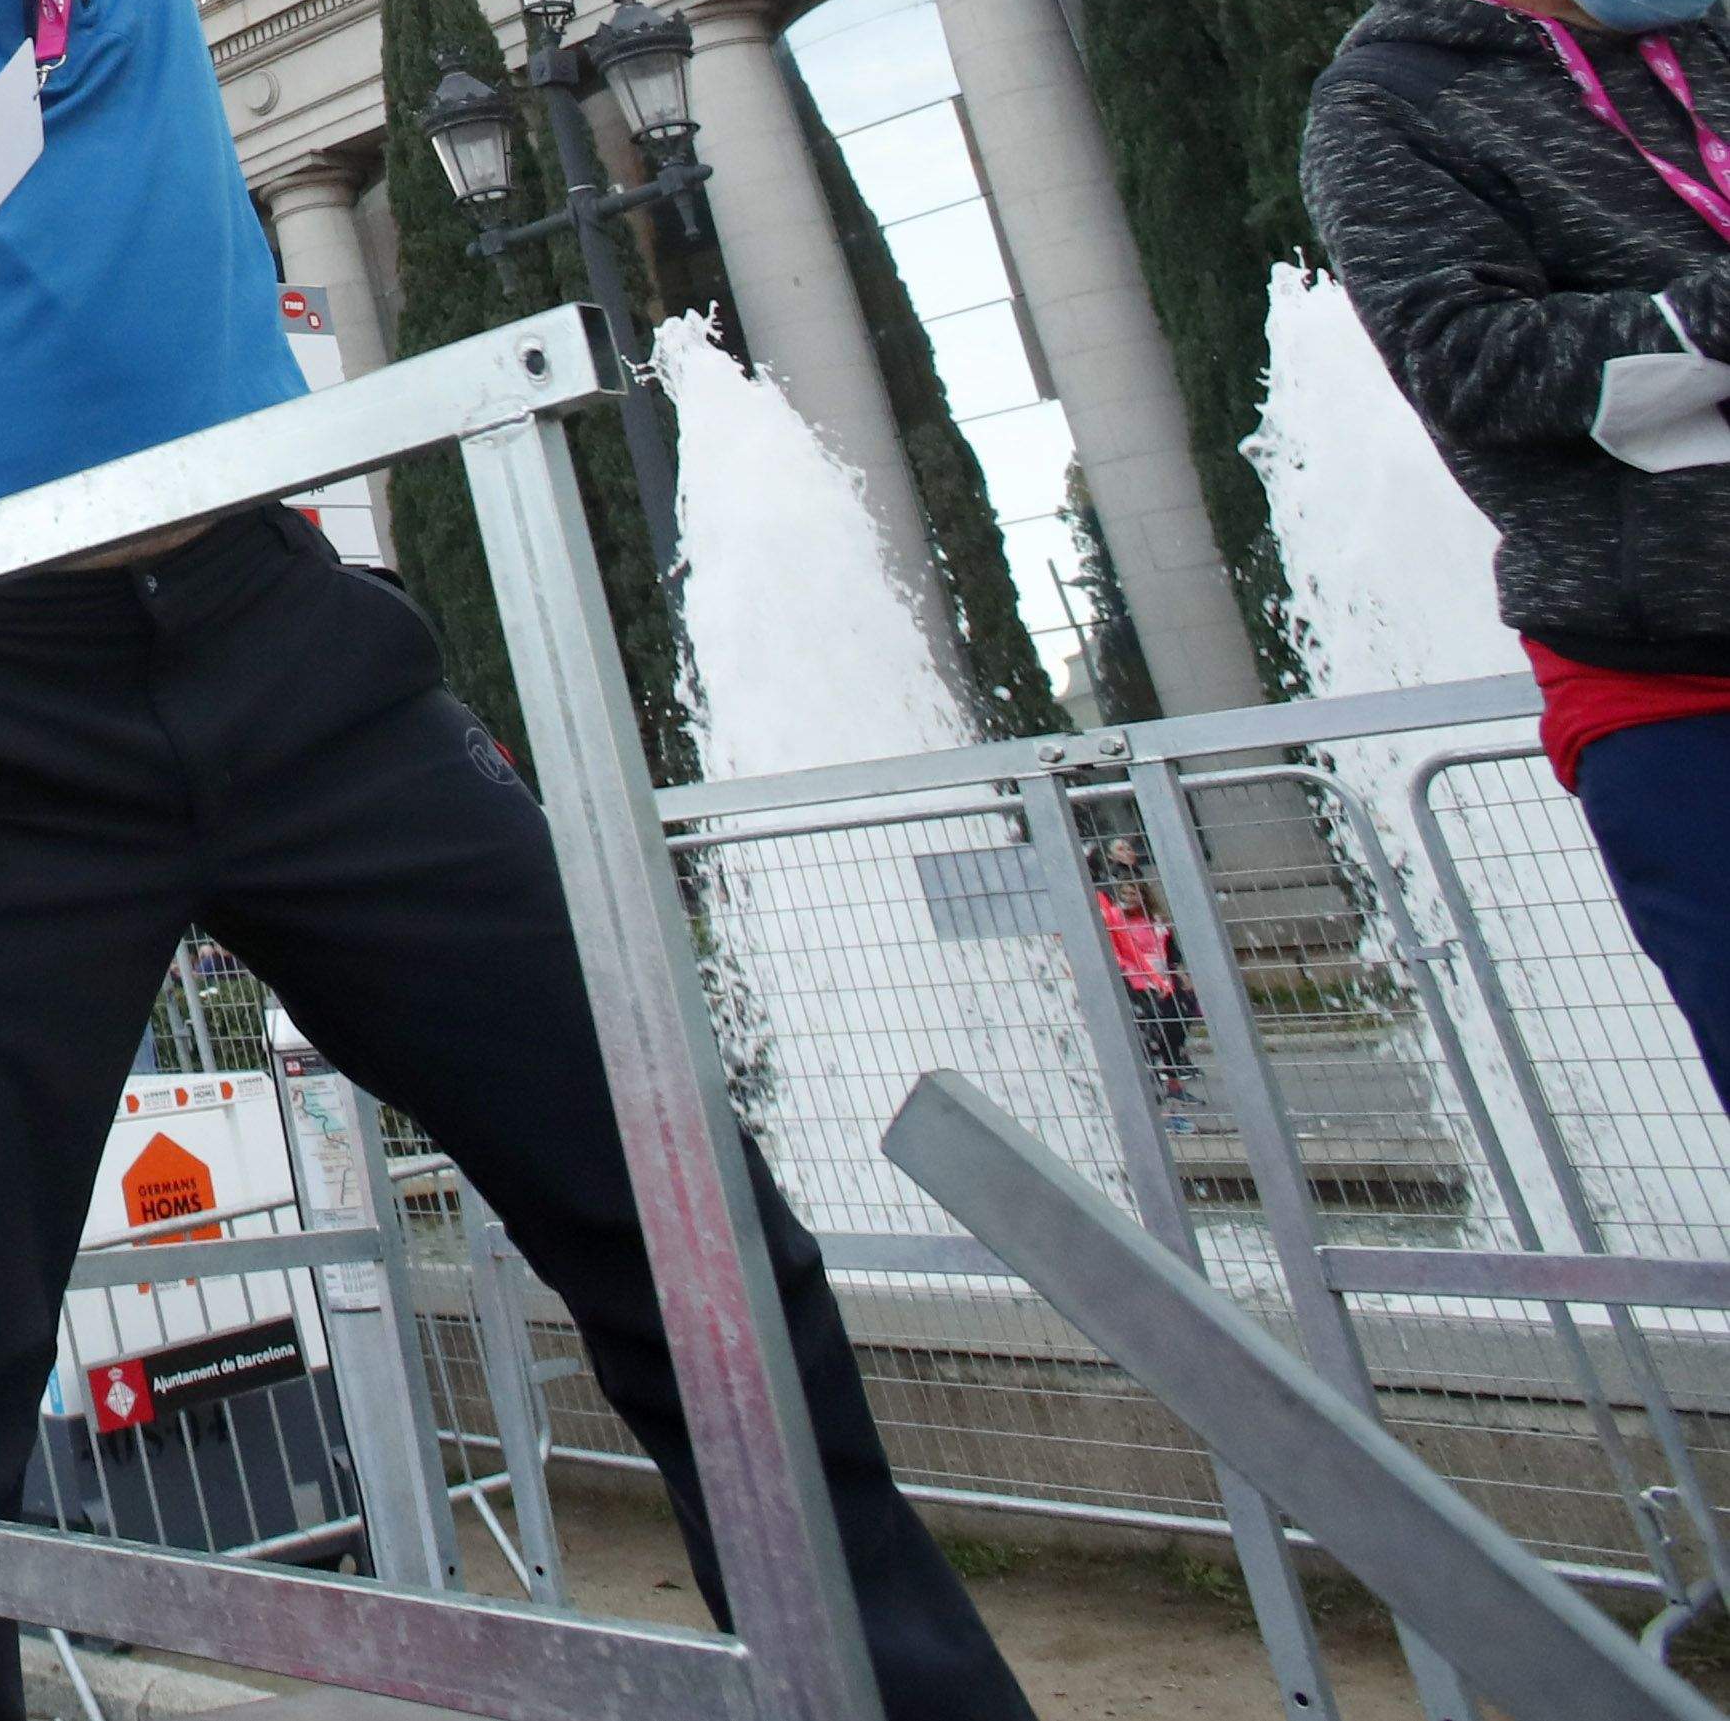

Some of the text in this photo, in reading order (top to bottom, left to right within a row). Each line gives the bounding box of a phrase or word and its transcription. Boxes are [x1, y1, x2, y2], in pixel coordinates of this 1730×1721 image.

[138, 1178, 198, 1198] GERMANS
[140, 1193, 203, 1223] HOMS
[152, 1343, 297, 1396] Ajuntament de Barcelona
